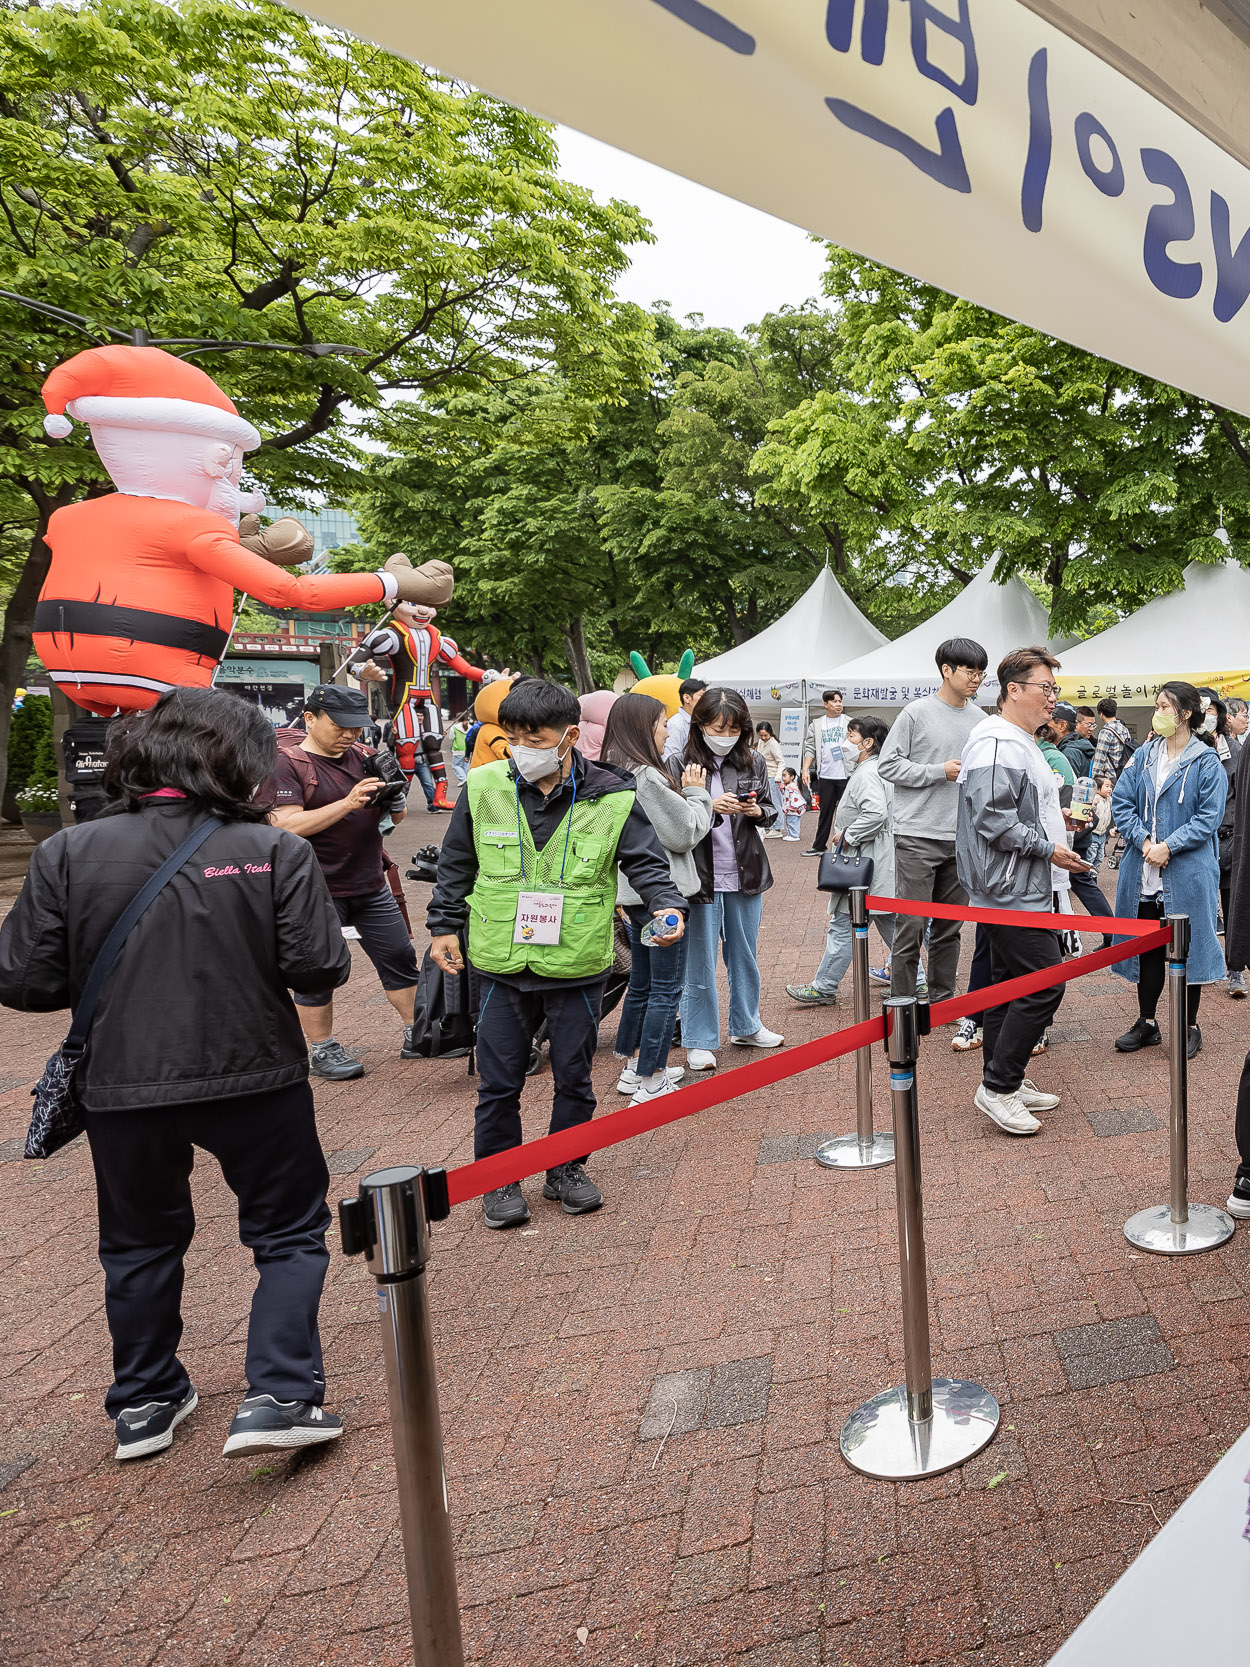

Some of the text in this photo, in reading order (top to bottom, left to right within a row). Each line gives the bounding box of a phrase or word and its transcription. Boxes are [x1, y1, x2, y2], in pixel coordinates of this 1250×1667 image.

[733, 687, 762, 700] 식체험
[852, 686, 898, 700] 문화재발굴
[901, 686, 910, 700] 및
[203, 865, 241, 878] Biella
[520, 913, 557, 924] 자원봉사
